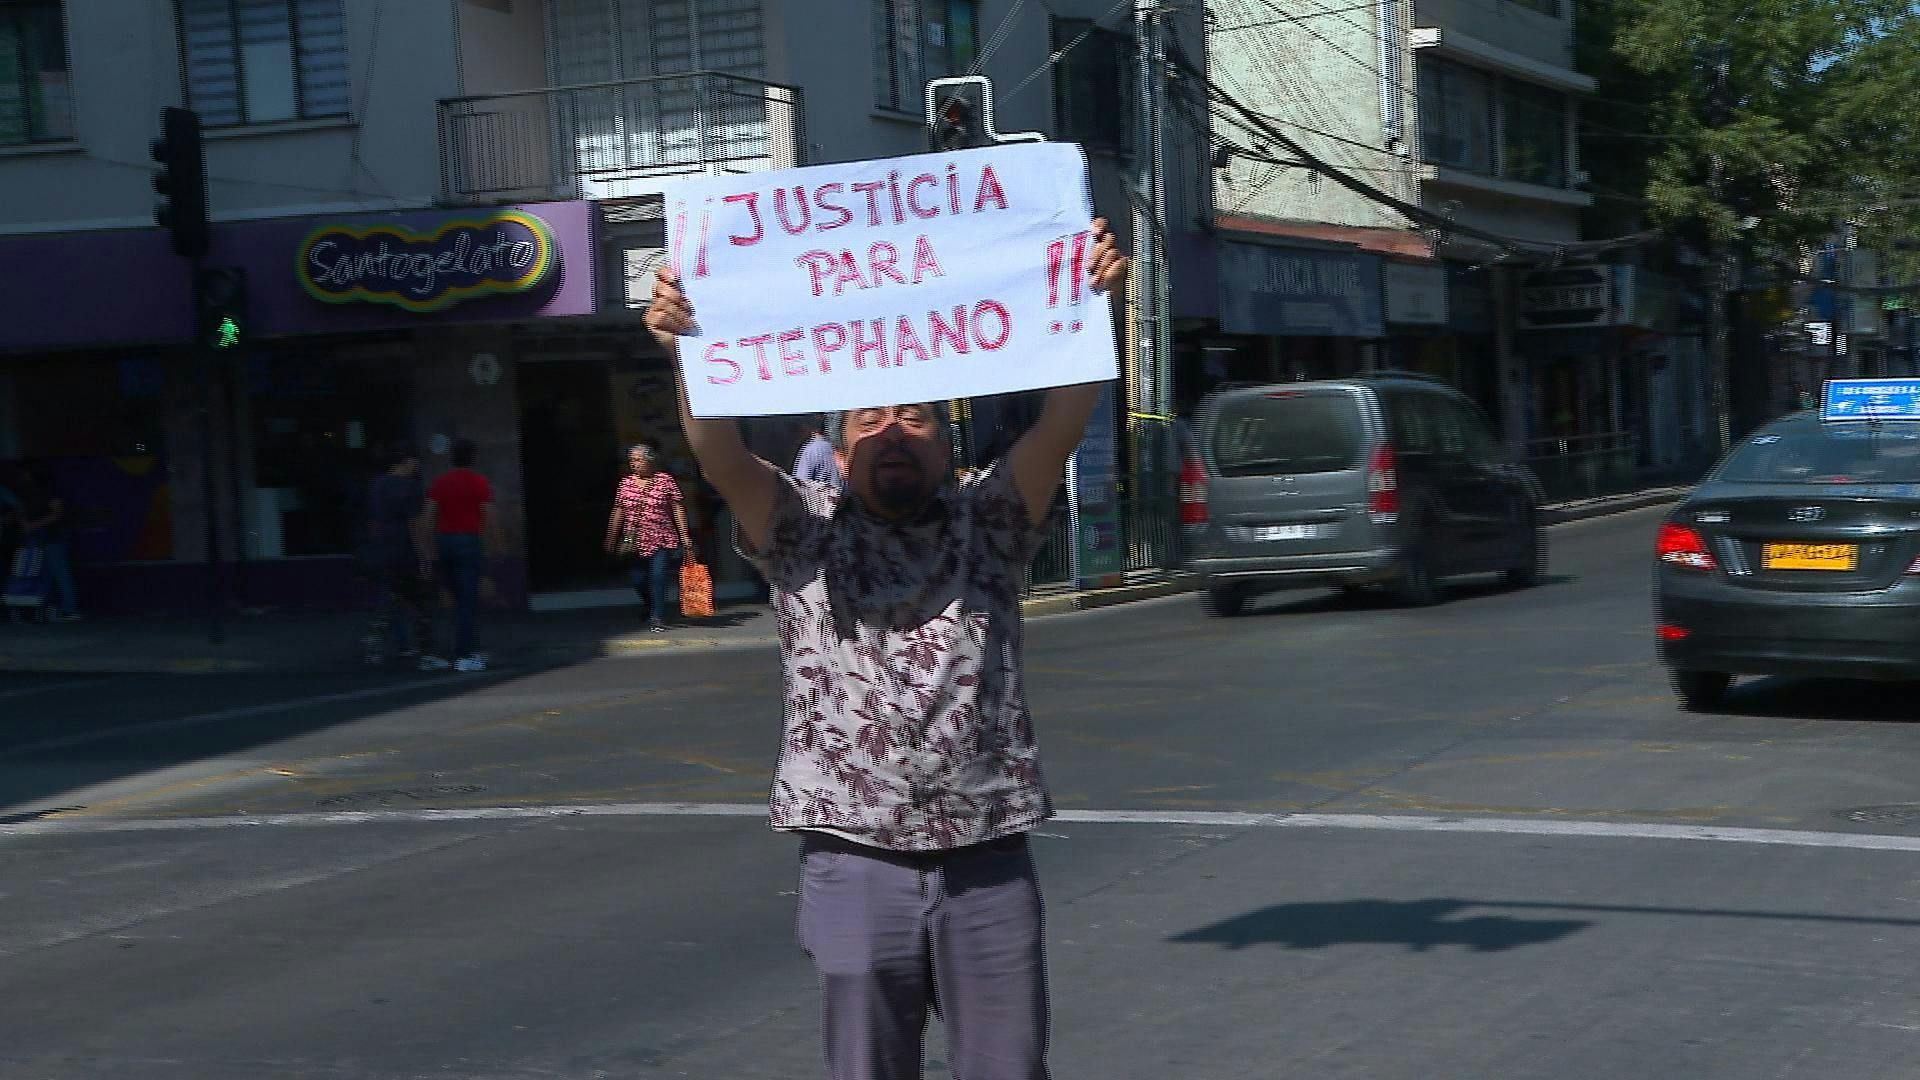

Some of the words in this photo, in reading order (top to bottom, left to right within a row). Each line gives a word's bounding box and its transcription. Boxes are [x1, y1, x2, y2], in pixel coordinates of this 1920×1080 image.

[308, 231, 535, 294] Santogelato
[794, 233, 948, 297] PARA
[701, 298, 1012, 386] STEPHANO
